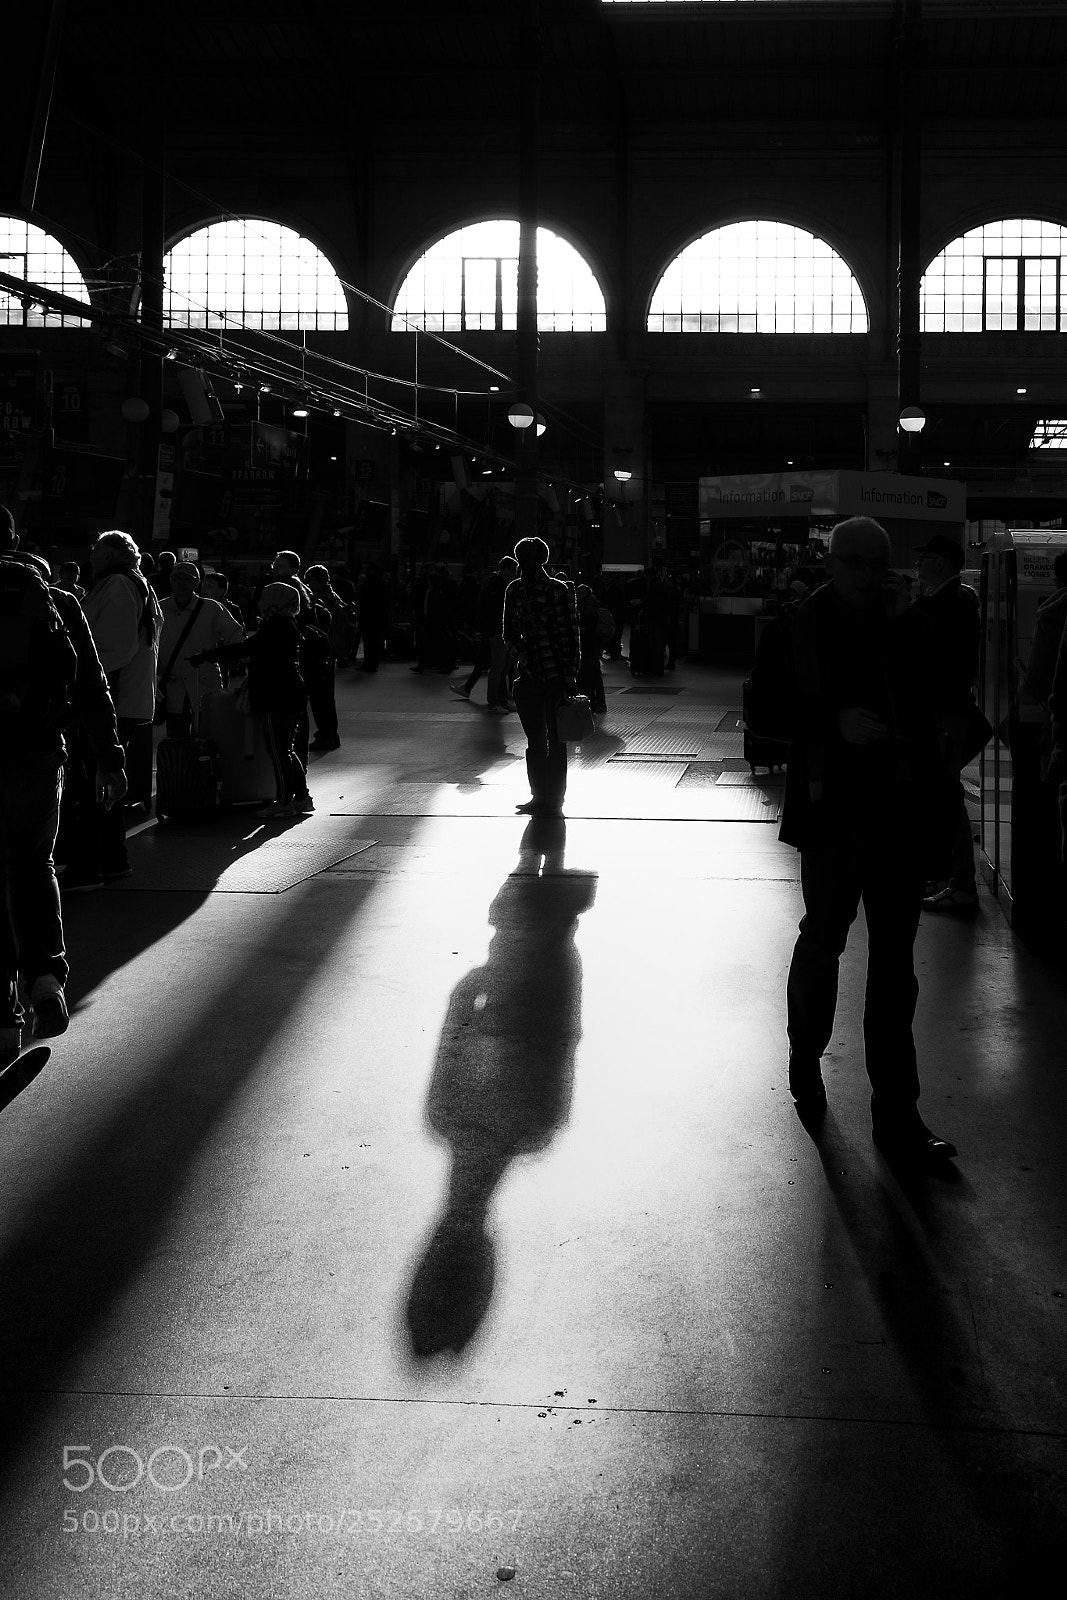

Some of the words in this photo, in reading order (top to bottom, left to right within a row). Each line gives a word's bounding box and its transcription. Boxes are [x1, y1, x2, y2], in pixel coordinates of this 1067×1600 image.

[62, 393, 81, 410] 10
[231, 470, 275, 480] SPARROW
[51, 474, 67, 495] 10
[718, 489, 786, 504] Information
[791, 489, 813, 502] SNCF
[860, 487, 923, 506] Information
[927, 495, 947, 508] SNCF
